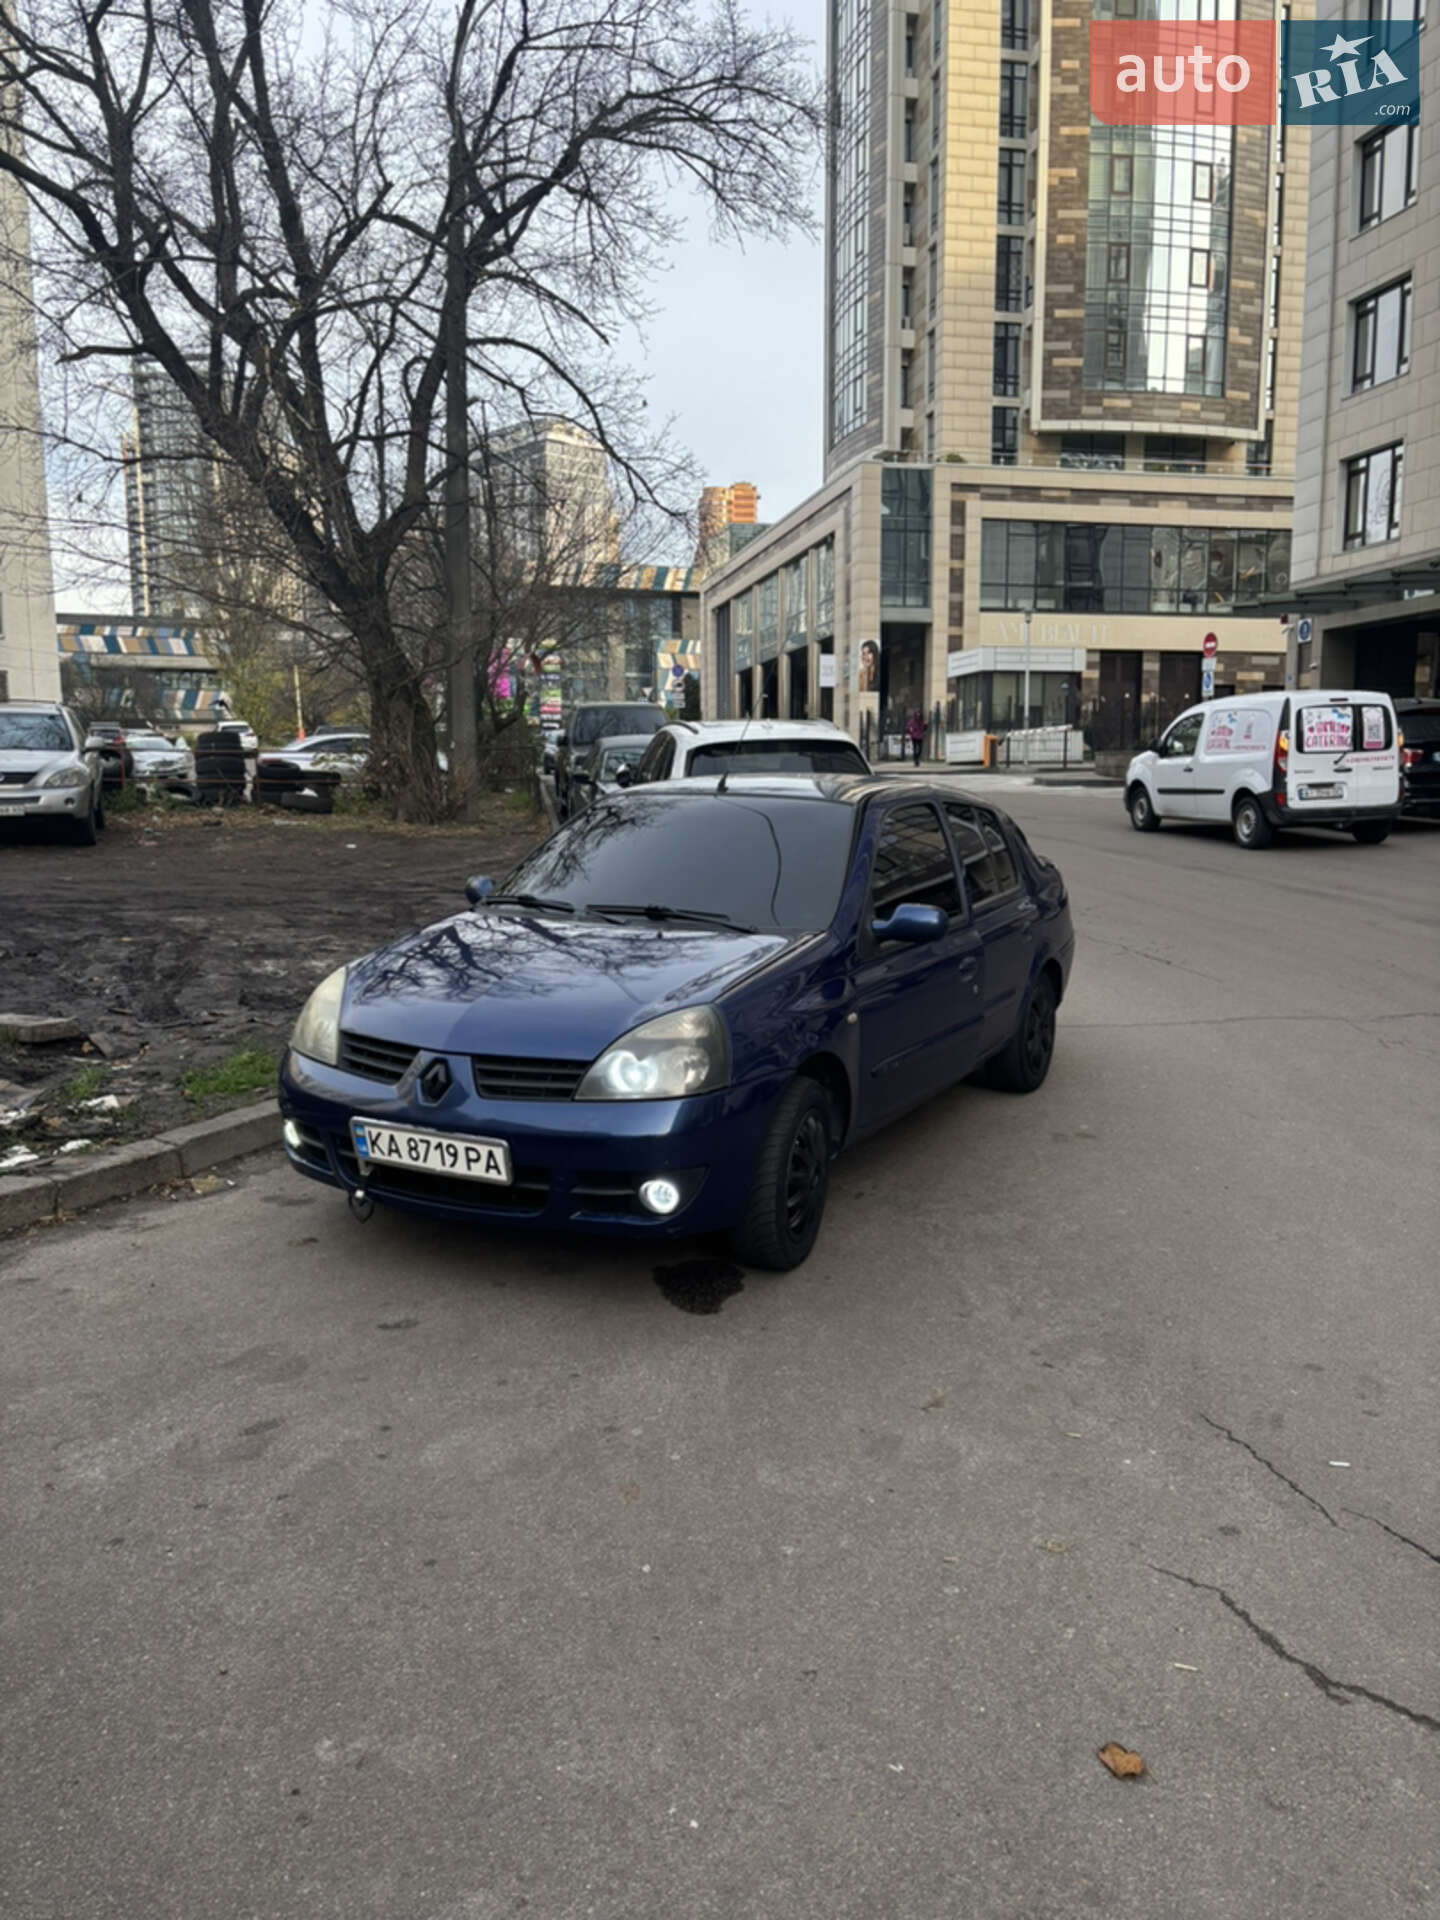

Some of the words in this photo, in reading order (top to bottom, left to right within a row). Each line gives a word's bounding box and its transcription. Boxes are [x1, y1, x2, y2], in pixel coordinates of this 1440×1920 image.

[368, 1130, 403, 1160] KA
[407, 1137, 458, 1168] 8719
[464, 1146, 502, 1175] PA
